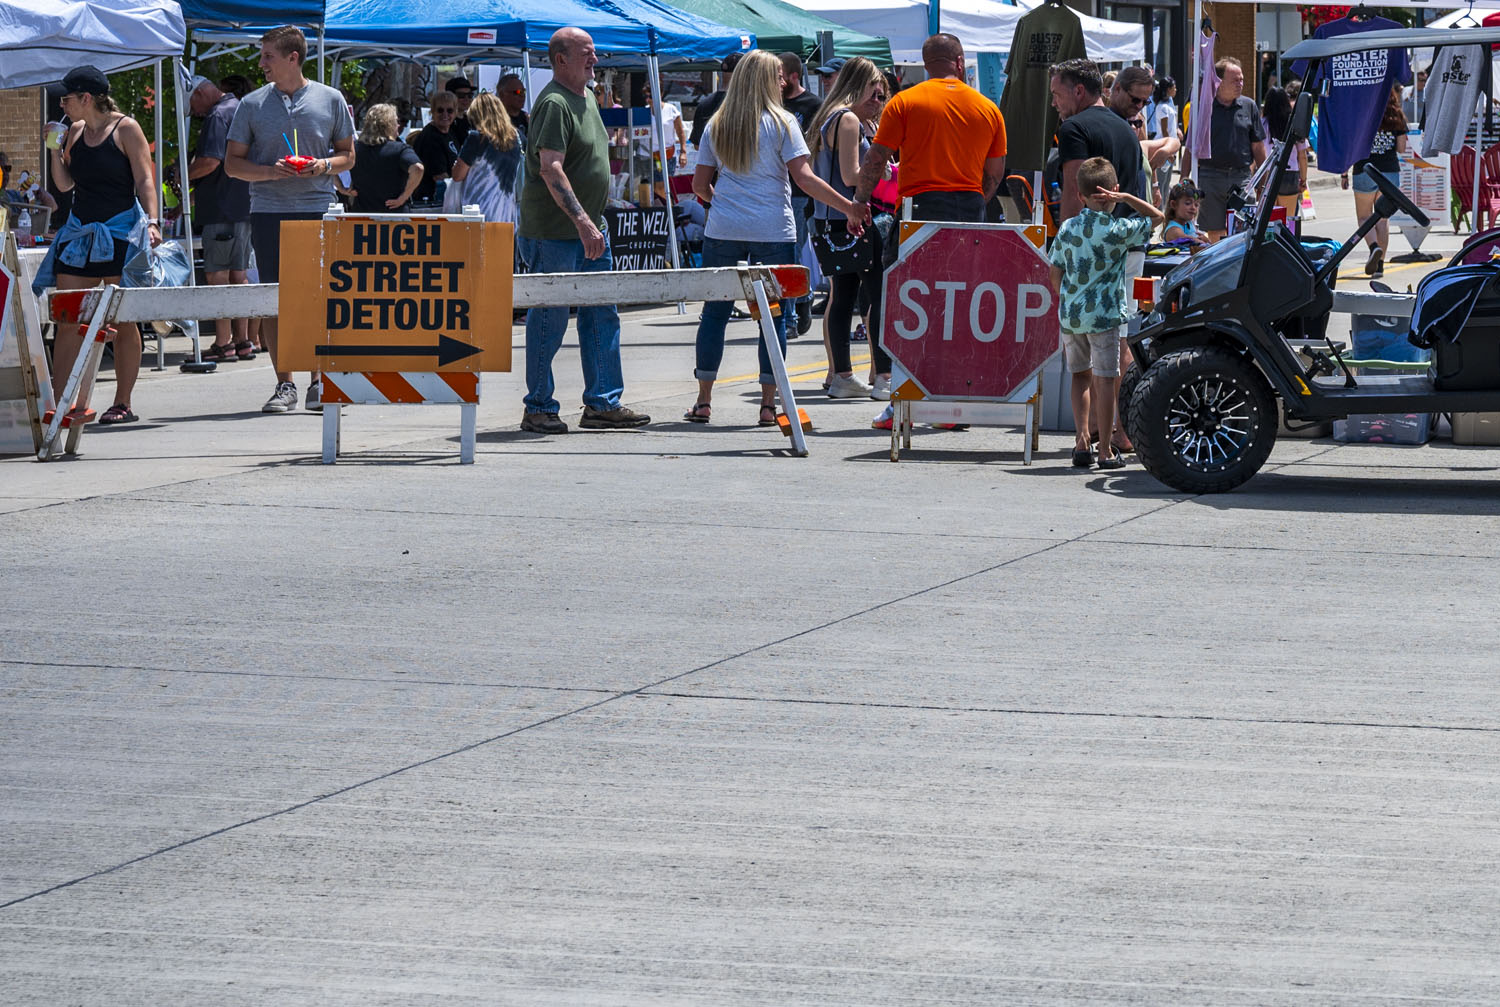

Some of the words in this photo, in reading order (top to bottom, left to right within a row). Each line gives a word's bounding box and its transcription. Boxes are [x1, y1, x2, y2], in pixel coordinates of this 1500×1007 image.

[1332, 58, 1388, 69] FOUNDATION
[1334, 69, 1353, 79] PIT
[1355, 66, 1386, 78] CREW
[616, 212, 639, 237] THE
[353, 224, 441, 256] HIGH
[628, 241, 657, 249] CHURCH
[329, 260, 465, 293] STREET
[326, 298, 470, 330] DETOUR
[893, 279, 1053, 343] STOP
